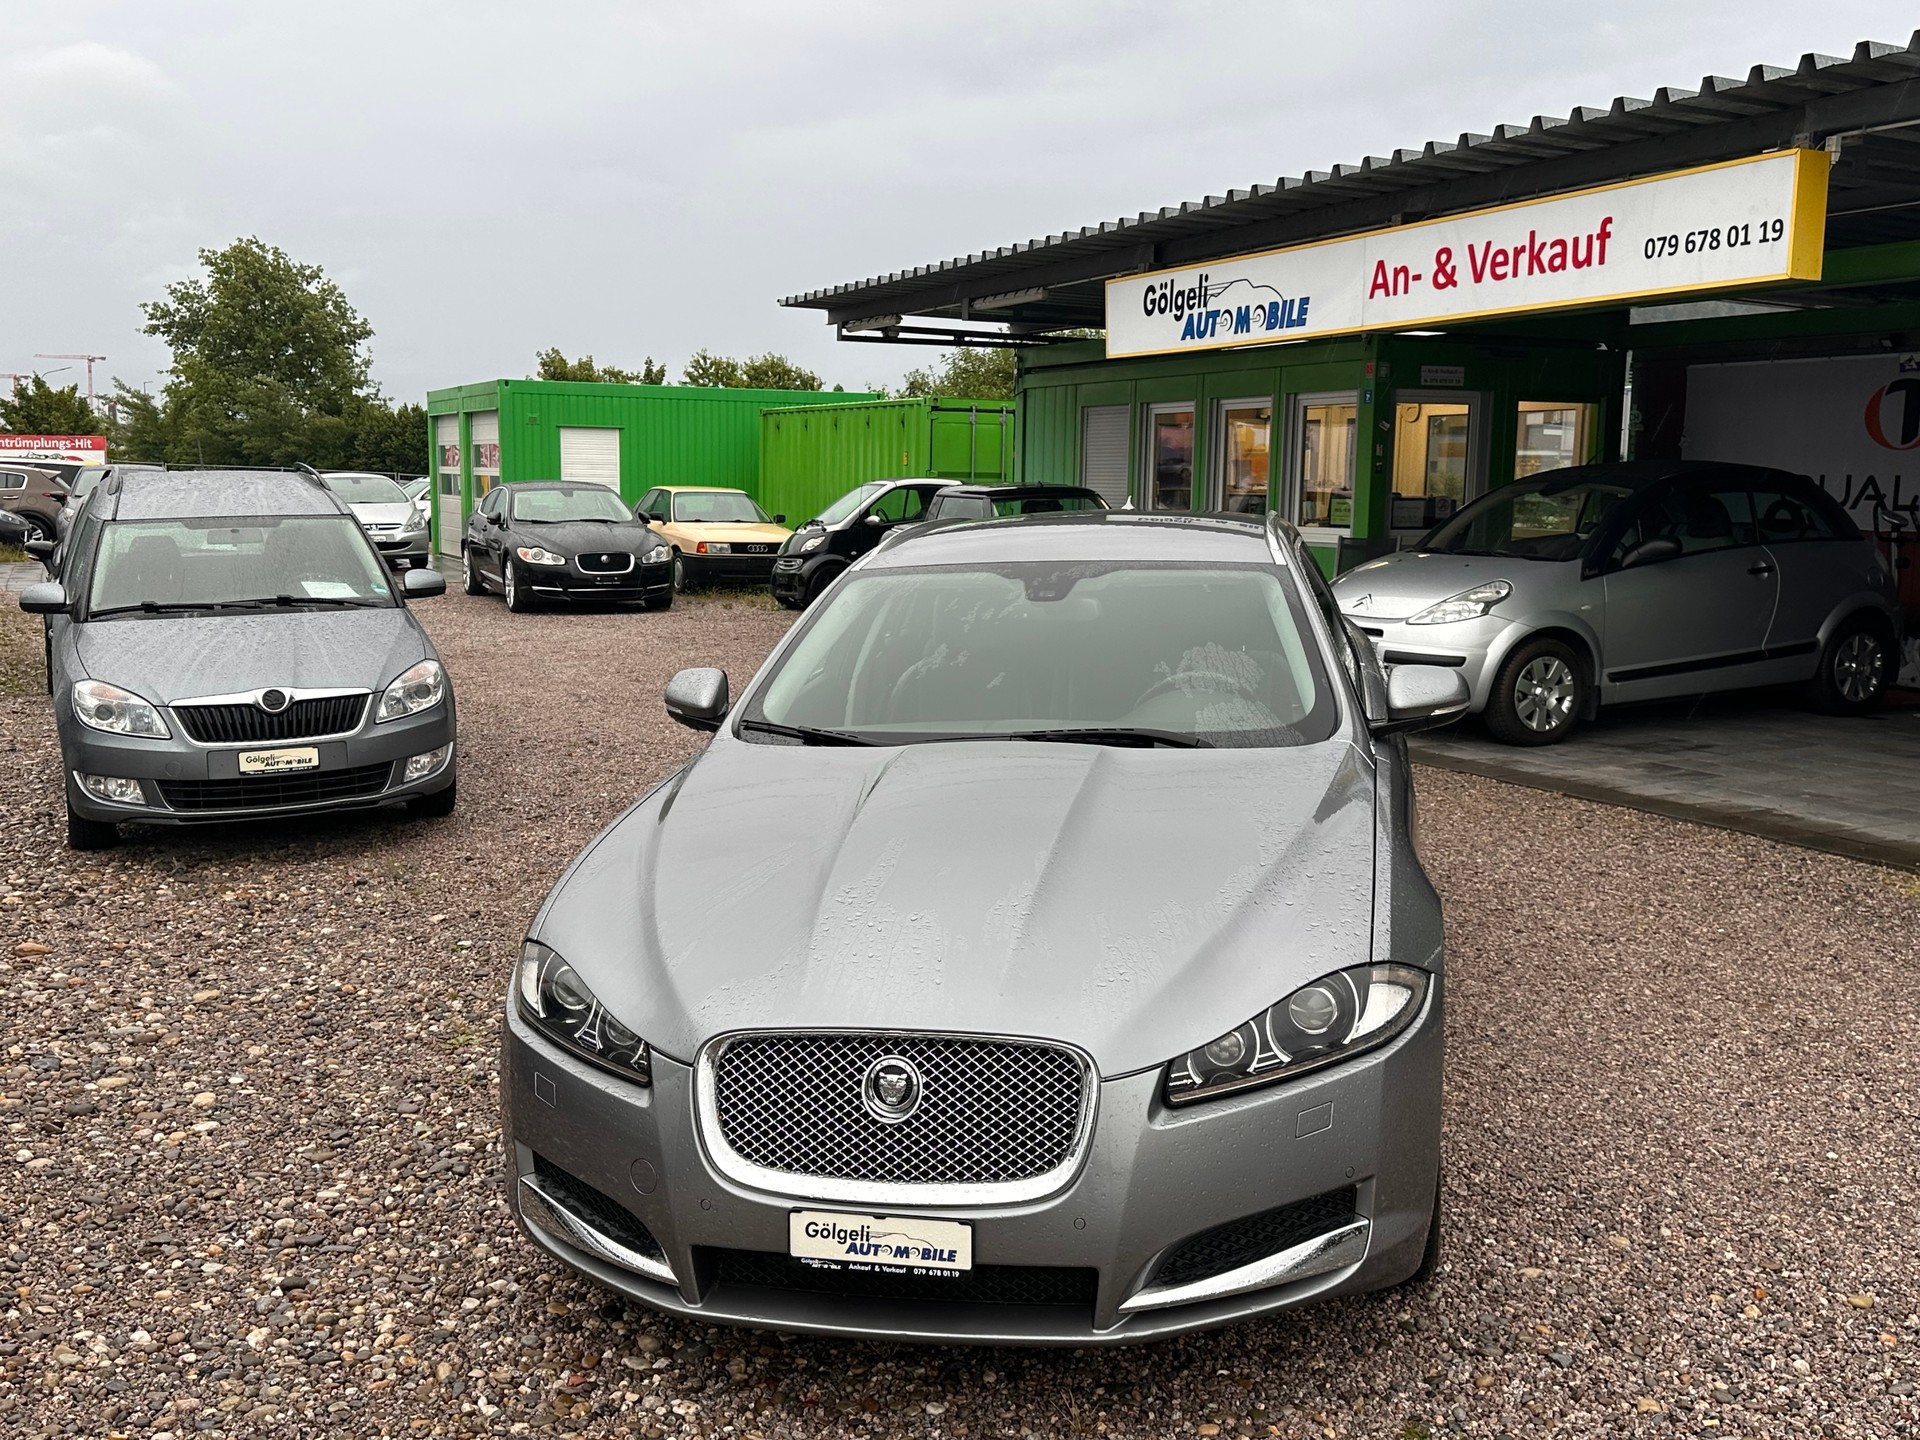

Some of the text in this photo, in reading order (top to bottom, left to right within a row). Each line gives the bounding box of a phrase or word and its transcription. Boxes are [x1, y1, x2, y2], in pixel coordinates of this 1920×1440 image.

[1369, 215, 1613, 299] An- & Verkauf
[1644, 218, 1784, 260] 079 678 01 19
[1143, 273, 1209, 322] Gölgeli
[805, 1221, 870, 1245] Gölgeli
[848, 1263, 872, 1271] Ankauf
[882, 1265, 907, 1274] Verkauf
[913, 1267, 927, 1275] 079
[928, 1268, 942, 1277] 678
